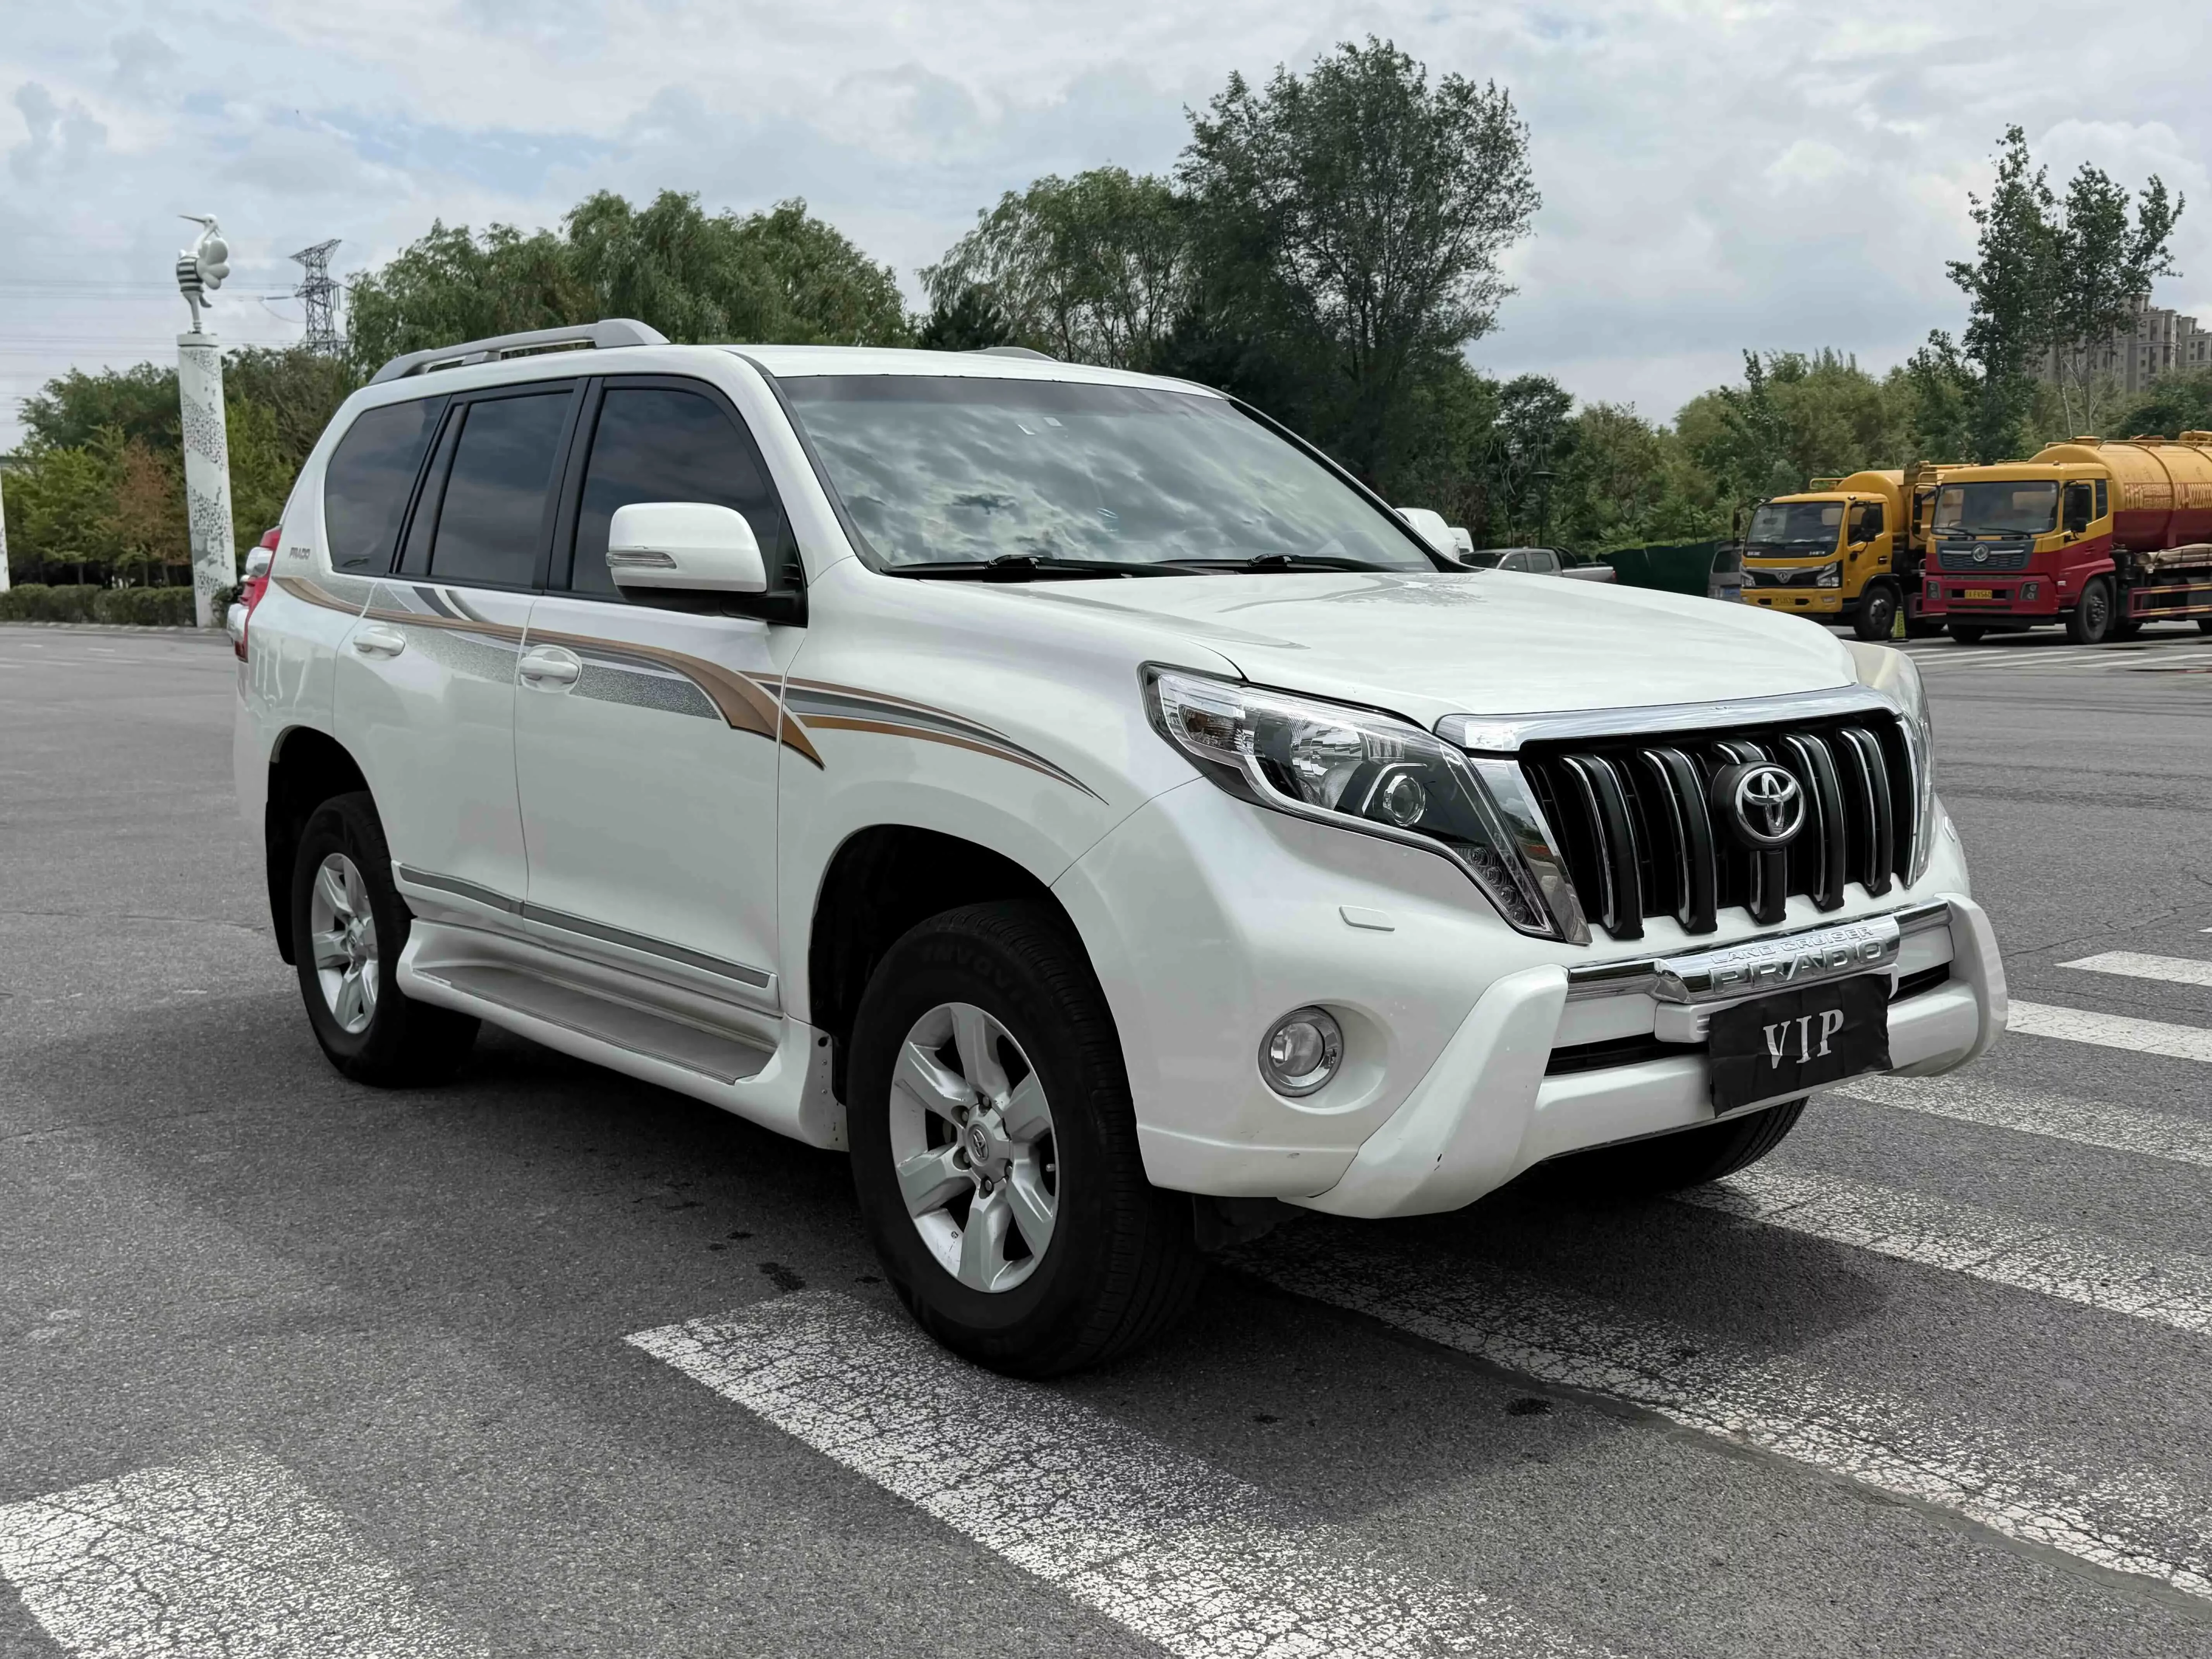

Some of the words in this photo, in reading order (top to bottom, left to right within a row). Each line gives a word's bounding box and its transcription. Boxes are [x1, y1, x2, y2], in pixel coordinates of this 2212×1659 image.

[289, 546, 311, 560] PRADO
[1709, 944, 1776, 963] LAND
[1780, 926, 1874, 952] CRUISER
[1709, 936, 1888, 993] PRADO
[1763, 1009, 1844, 1069] VIP
